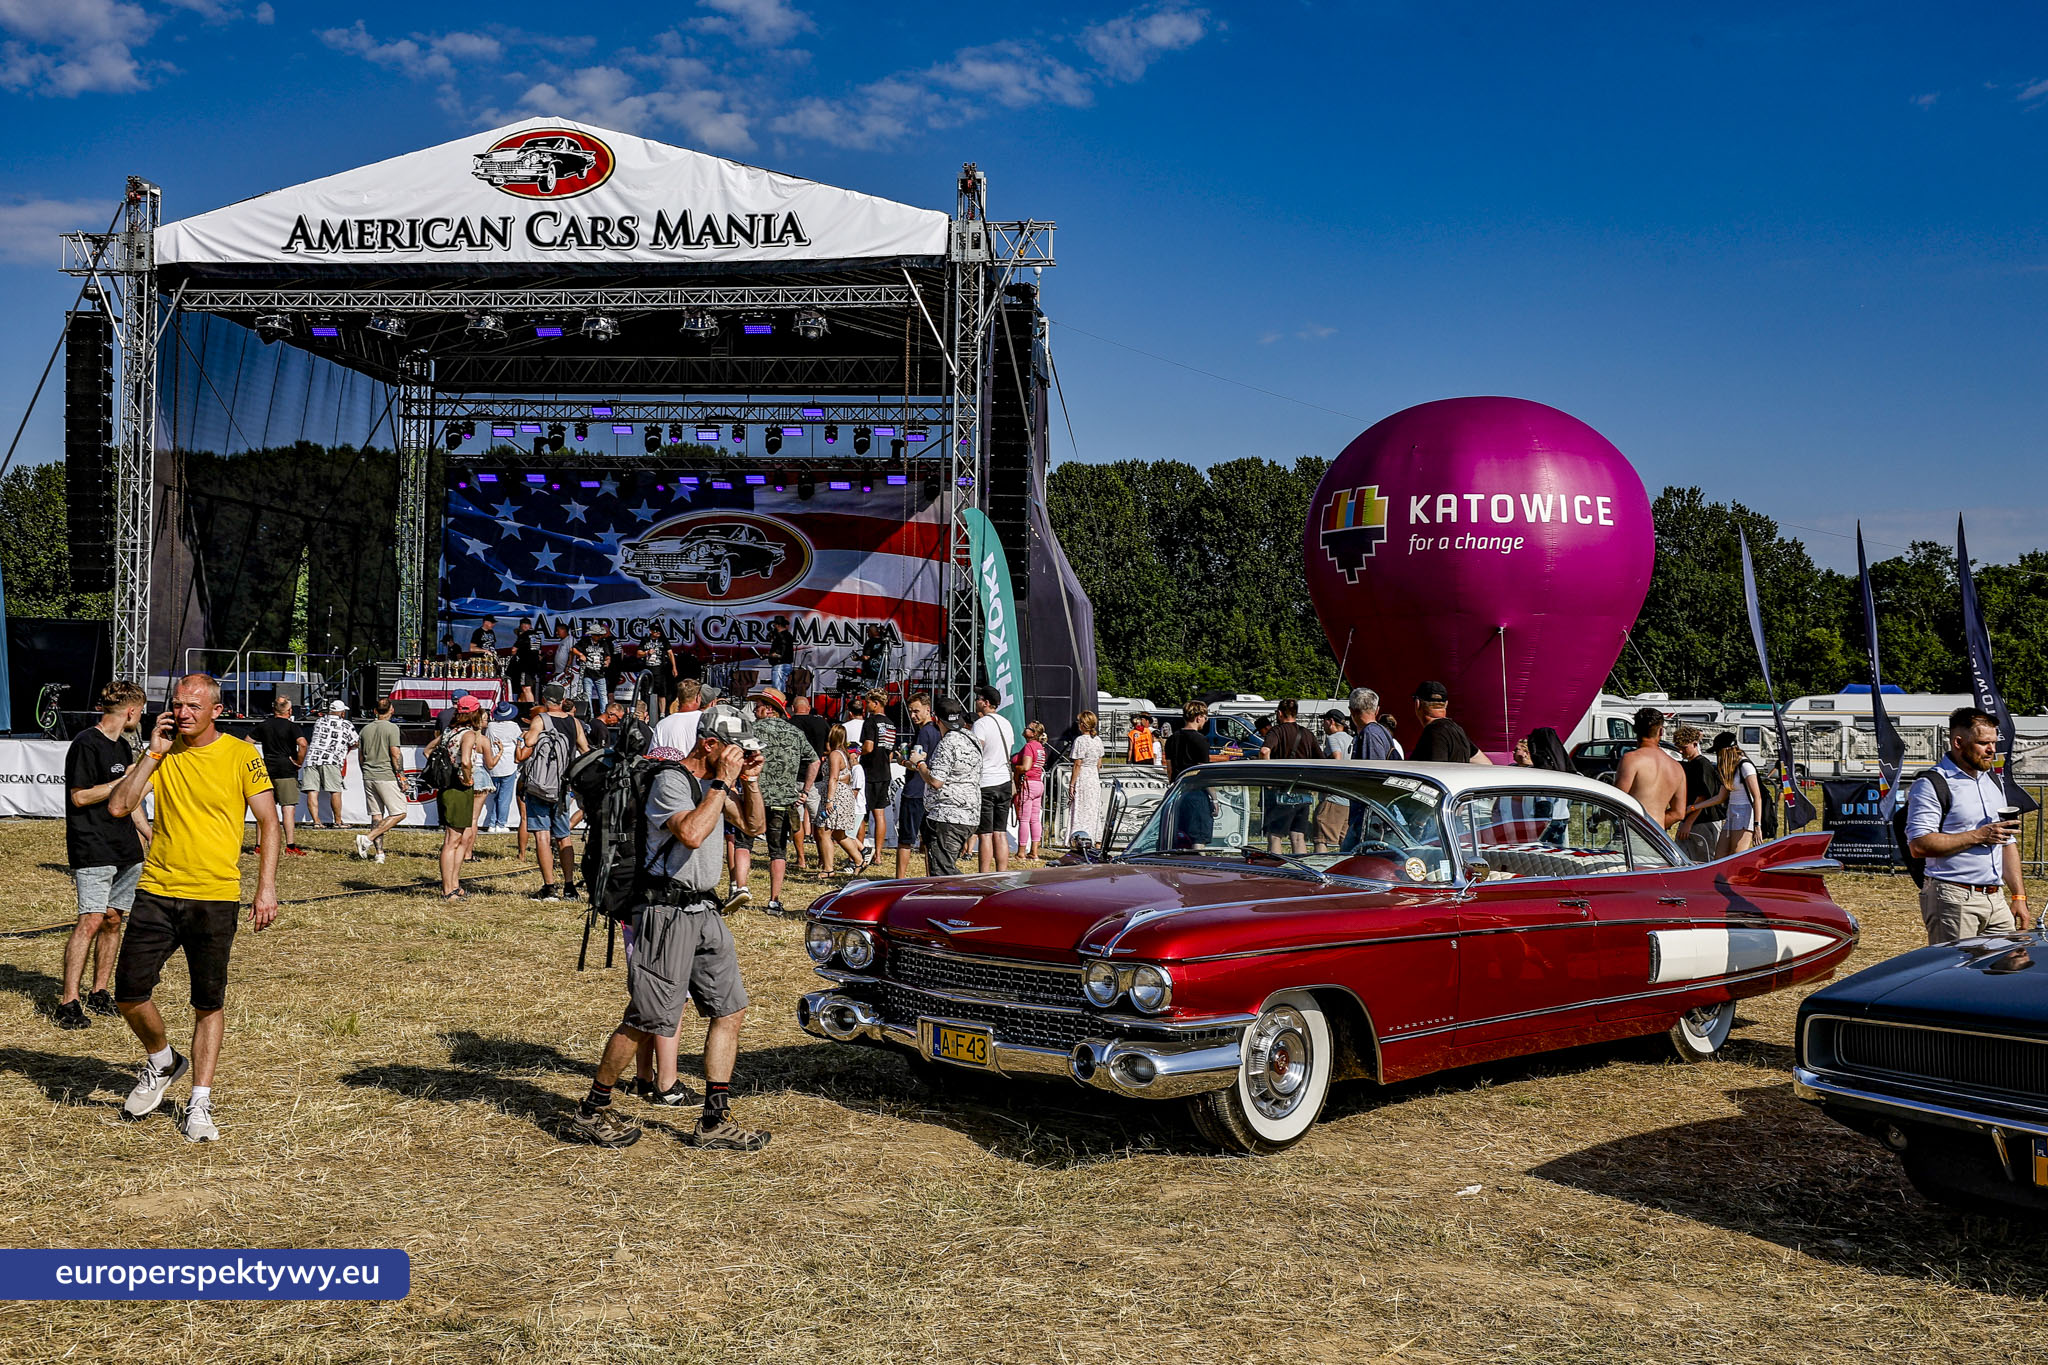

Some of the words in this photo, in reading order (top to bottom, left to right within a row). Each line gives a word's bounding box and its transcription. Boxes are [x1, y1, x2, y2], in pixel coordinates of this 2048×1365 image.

[281, 213, 515, 254] AMERICAN
[525, 210, 639, 250] CARS
[649, 208, 811, 250] MANIA
[1409, 493, 1614, 526] KATOWICE
[1408, 533, 1434, 555] for
[1438, 536, 1449, 550] a
[1454, 533, 1524, 554] change
[246, 757, 262, 772] LEE
[2036, 1149, 2047, 1157] PL
